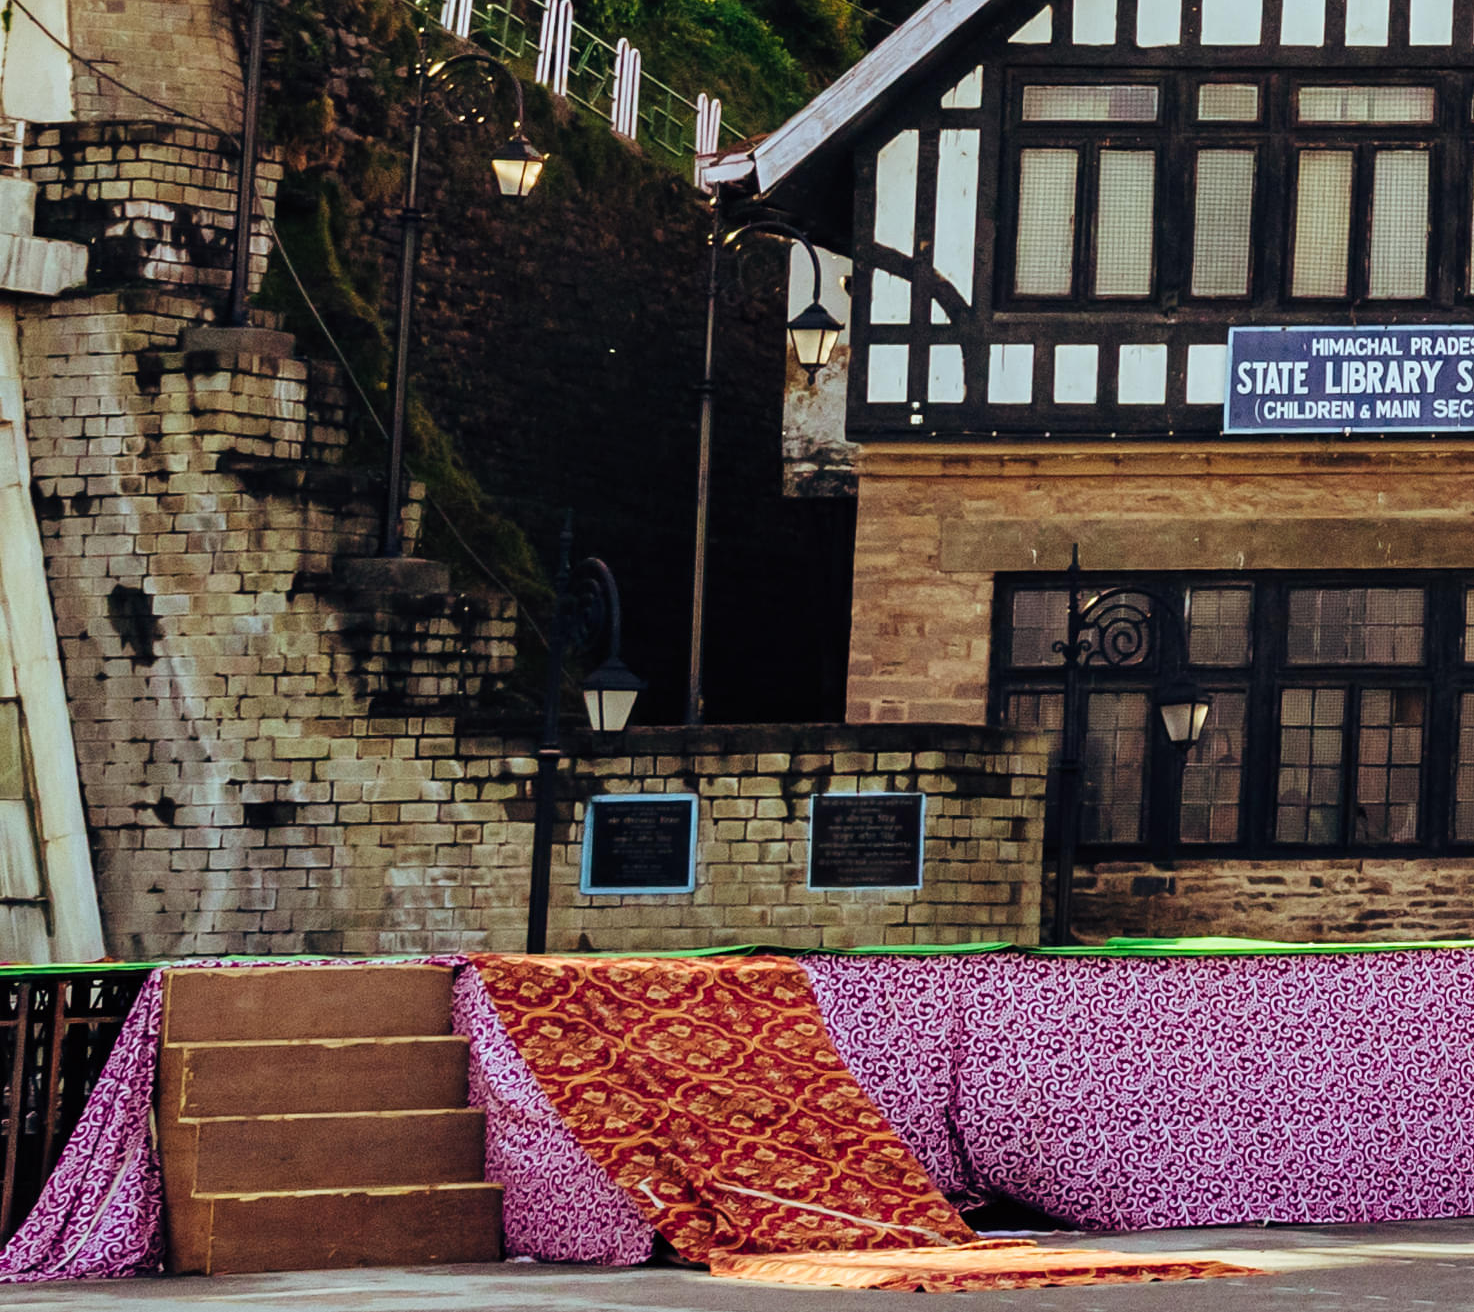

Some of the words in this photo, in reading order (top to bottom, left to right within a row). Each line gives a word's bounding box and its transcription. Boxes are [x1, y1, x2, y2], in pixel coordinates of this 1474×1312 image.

[1312, 337, 1403, 357] HIMACHAL
[1236, 361, 1309, 395] STATE
[1325, 359, 1444, 394] LIBRARY
[1254, 398, 1354, 424] (CHILDREN
[1359, 404, 1371, 419] &
[1375, 399, 1420, 419] MAIN
